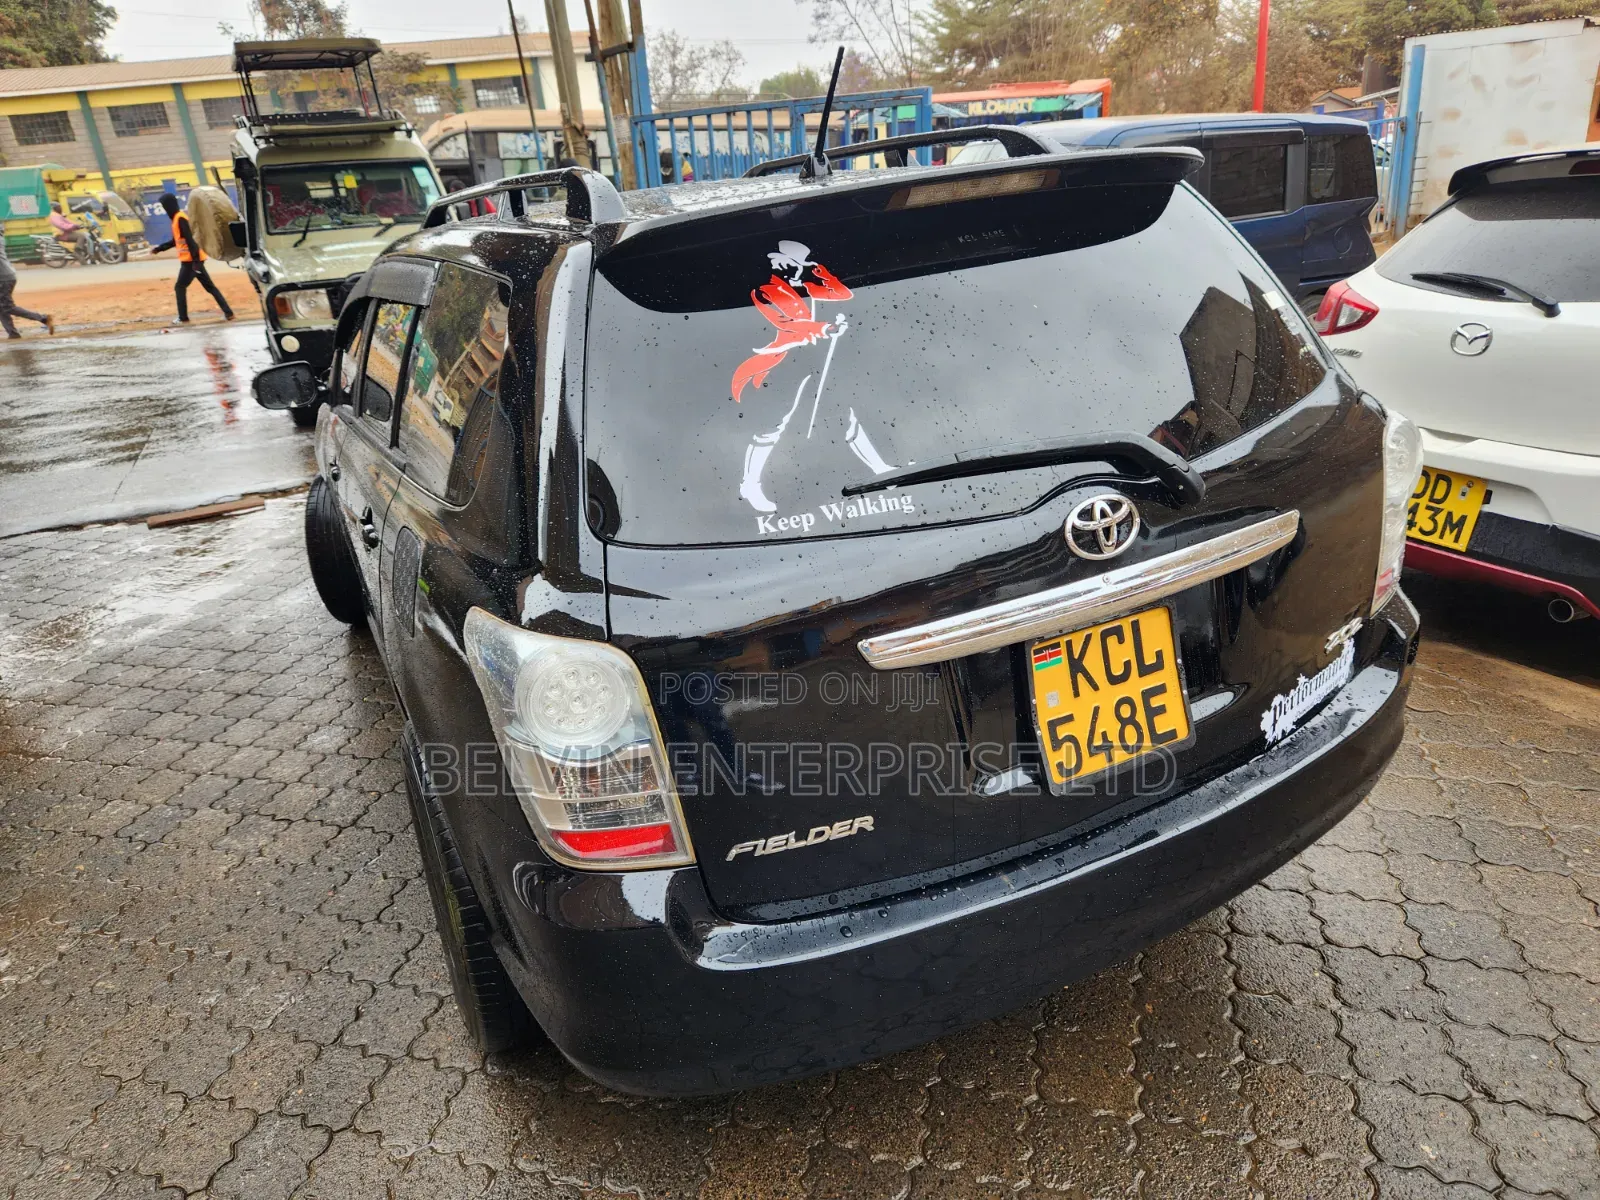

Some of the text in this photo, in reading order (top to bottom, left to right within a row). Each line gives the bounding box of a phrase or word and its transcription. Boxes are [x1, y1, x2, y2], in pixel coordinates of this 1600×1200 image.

[755, 494, 916, 535] Keep Walking
[1065, 618, 1165, 699] KCL
[1046, 682, 1178, 779] 548E
[725, 815, 875, 862] FIELDER
